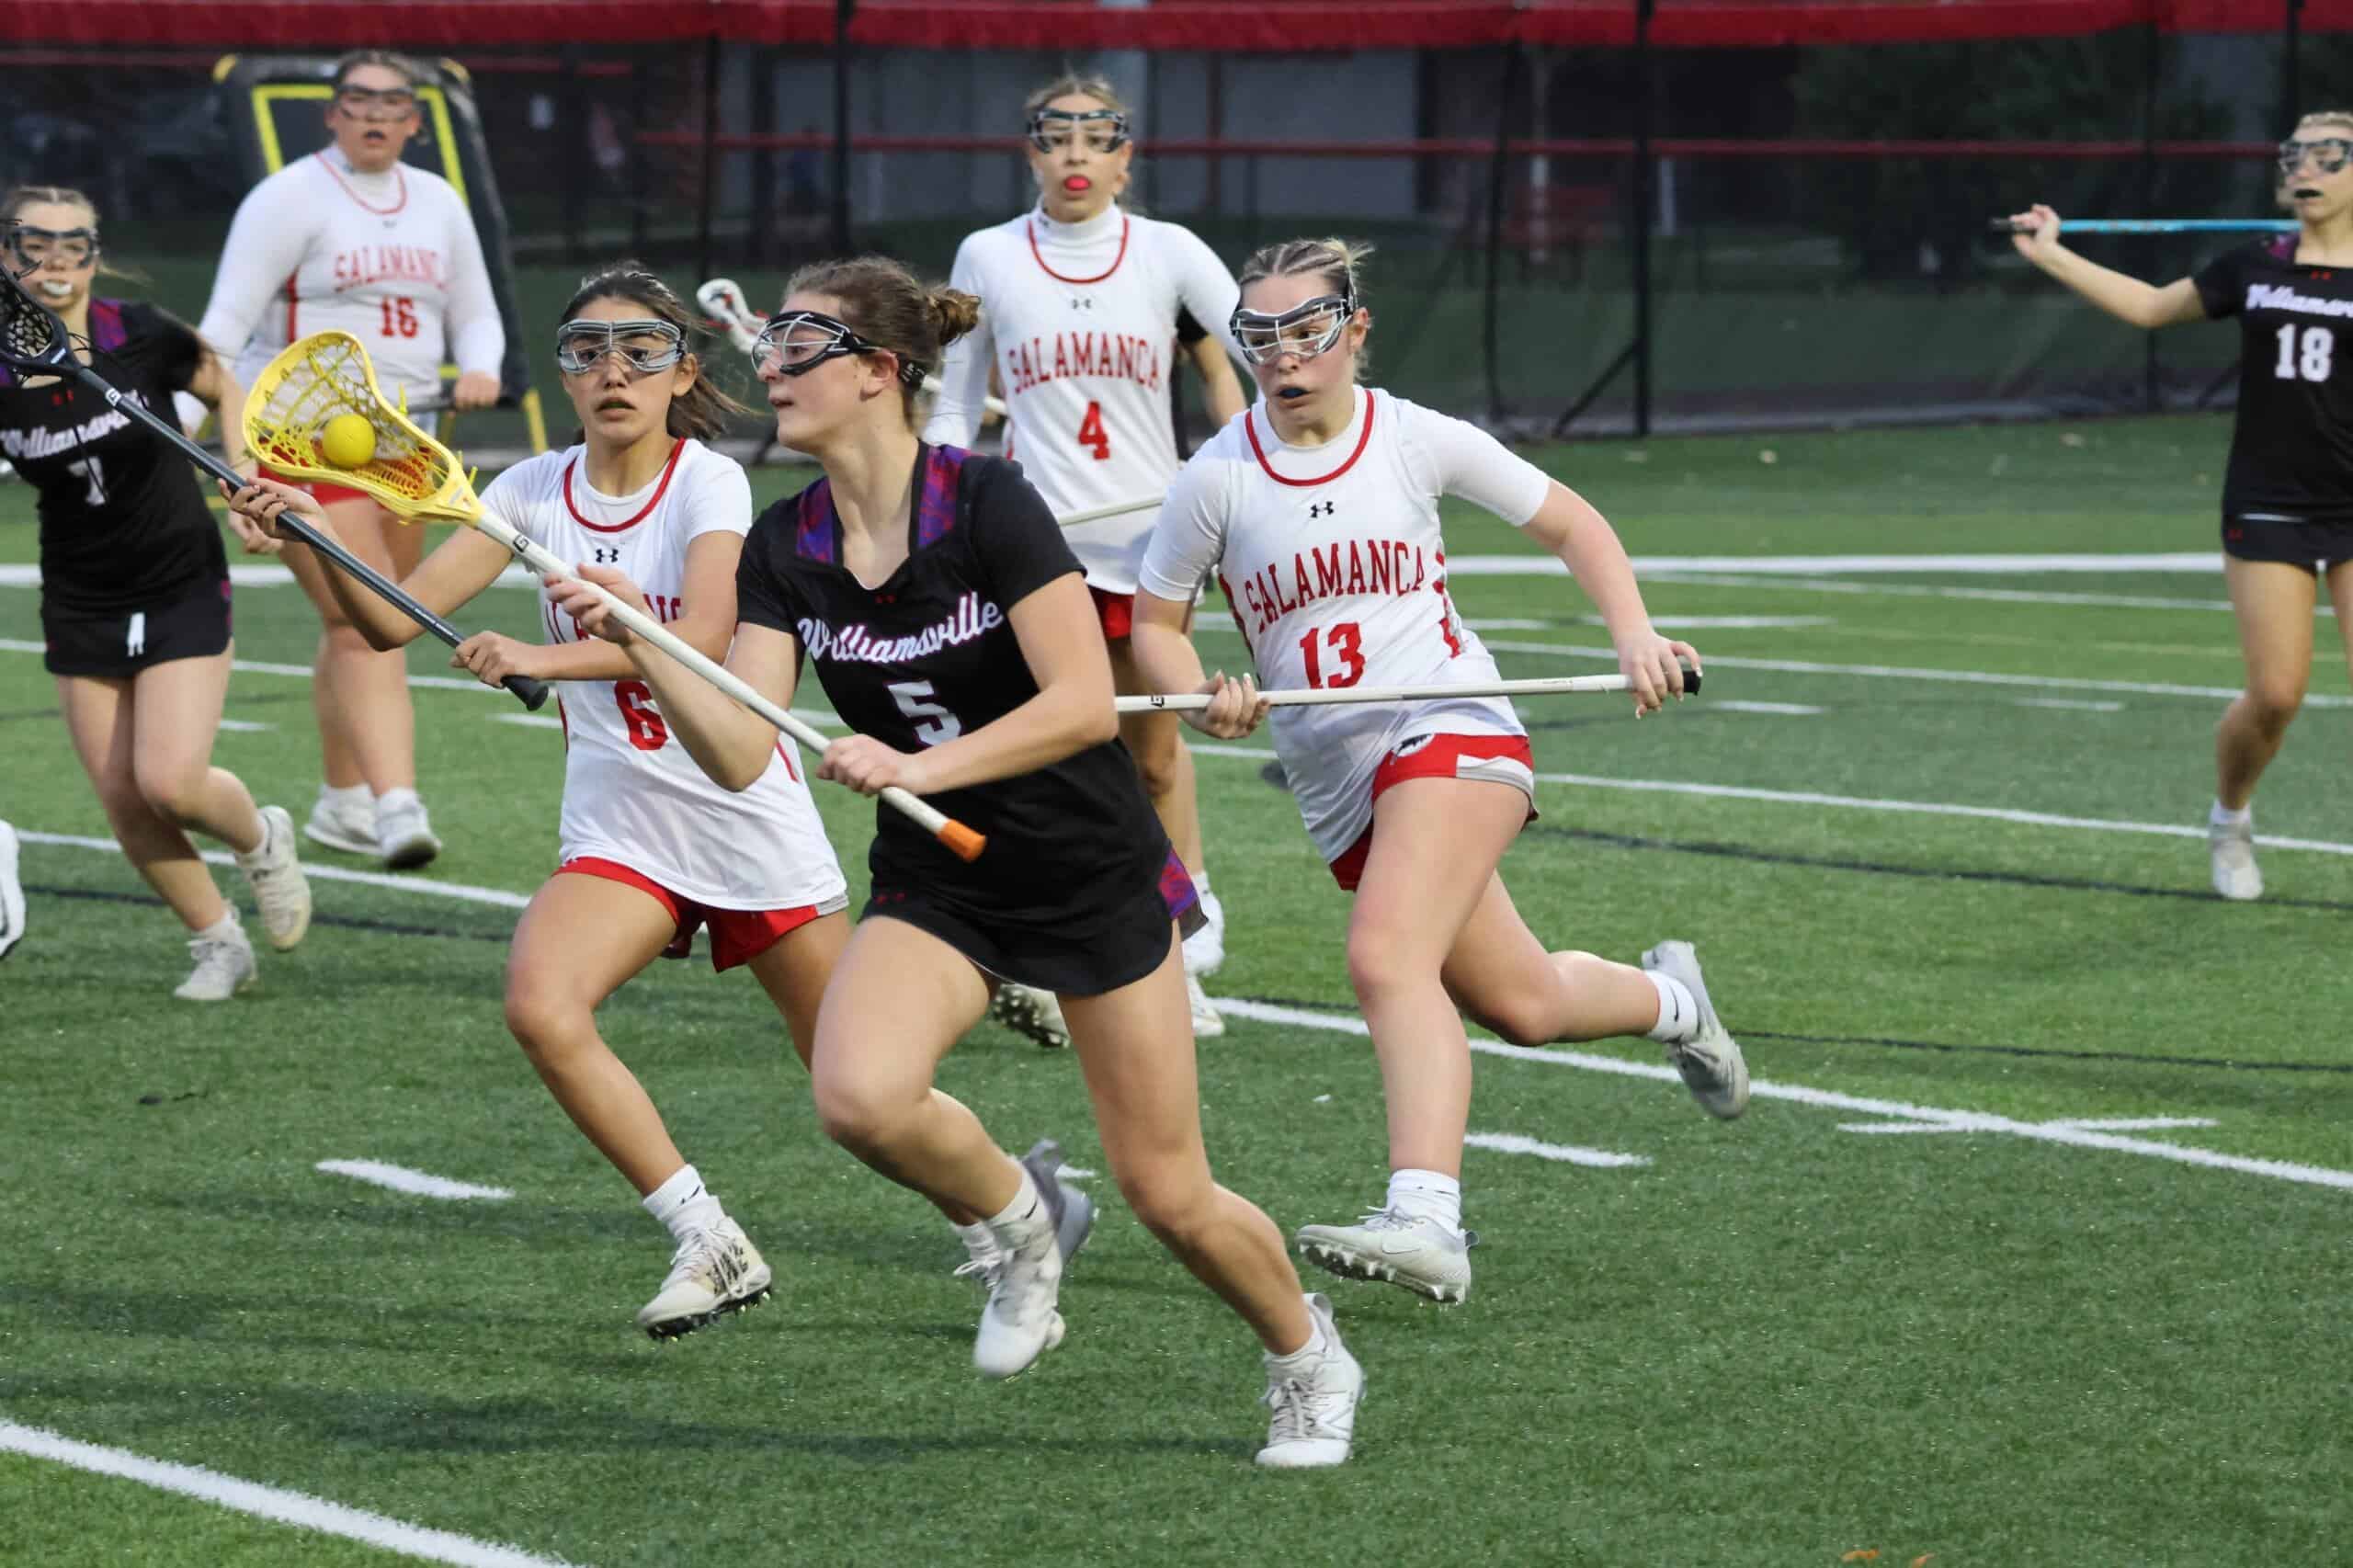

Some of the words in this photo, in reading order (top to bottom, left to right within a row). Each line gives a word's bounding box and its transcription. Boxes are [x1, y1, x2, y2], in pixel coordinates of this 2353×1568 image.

[380, 295, 418, 337] 16
[1008, 332, 1159, 393] SALAMANCA
[2275, 324, 2334, 381] 18
[1079, 400, 1109, 460] 4
[67, 456, 106, 506] 7
[1245, 539, 1426, 633] SALAMANCA
[797, 591, 1005, 664] Williamsville
[1300, 622, 1366, 689] 13
[614, 680, 668, 750] 6
[887, 679, 962, 745] 5
